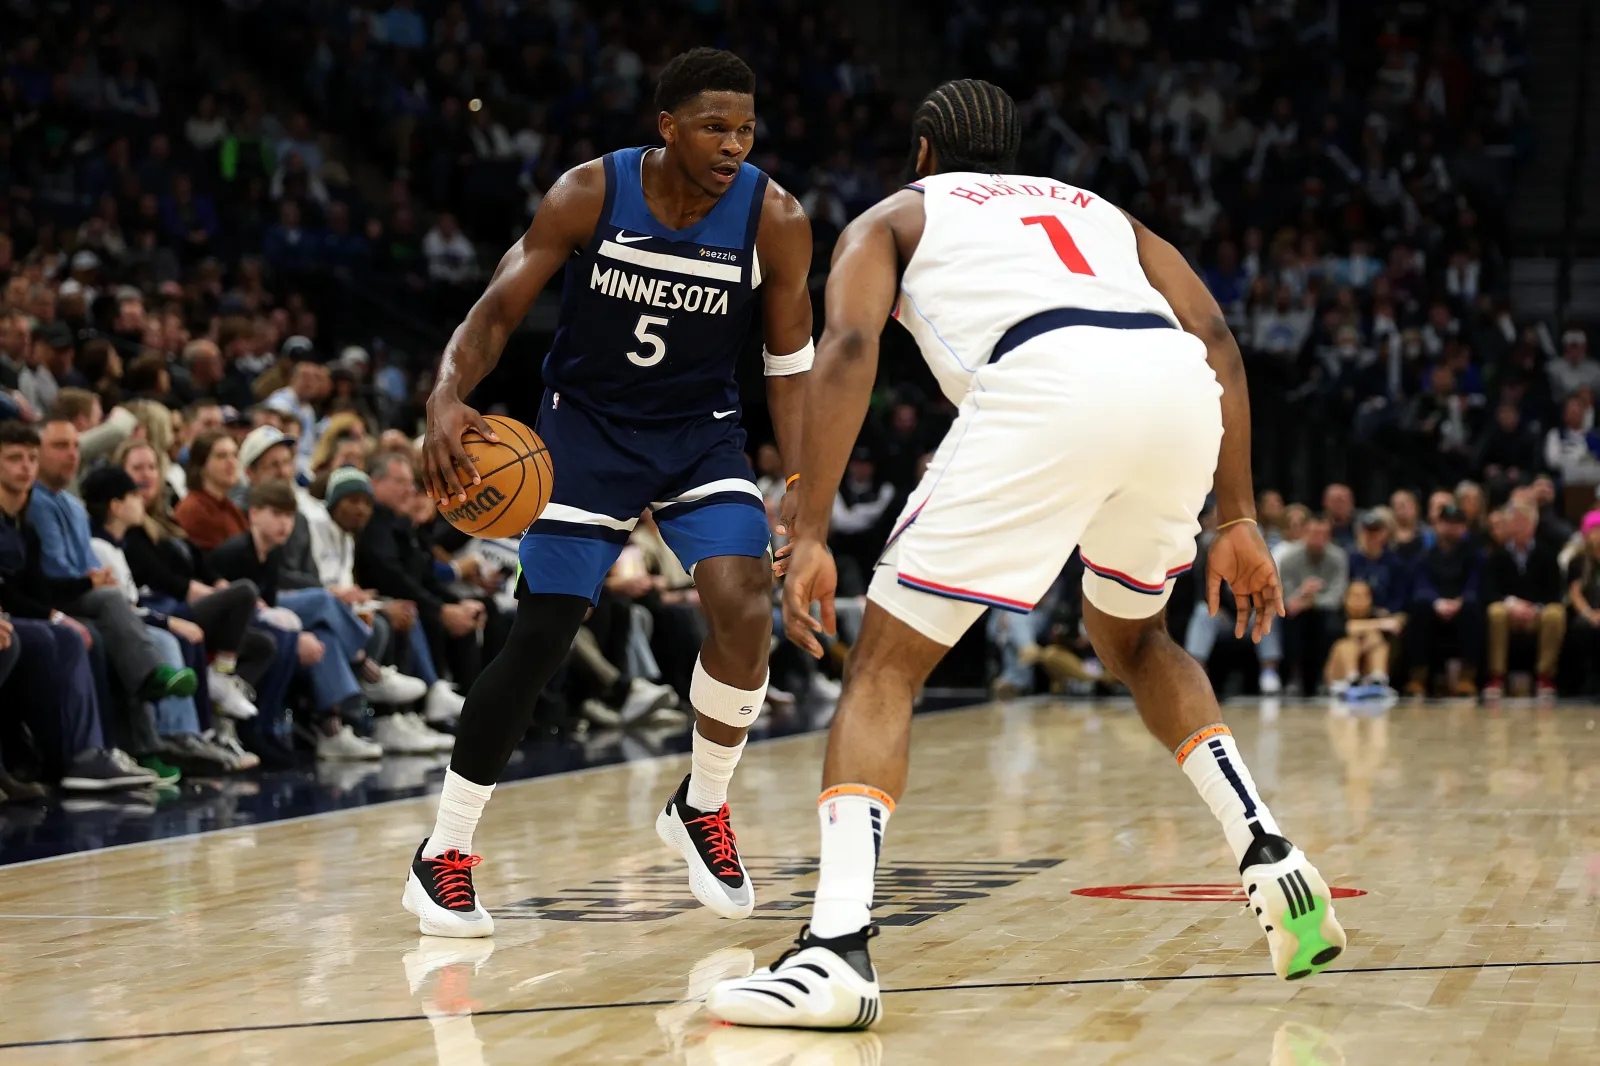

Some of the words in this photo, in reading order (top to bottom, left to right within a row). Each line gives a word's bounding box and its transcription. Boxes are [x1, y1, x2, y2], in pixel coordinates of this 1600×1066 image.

[949, 182, 1095, 208] HARDEN
[705, 249, 737, 262] sezzle
[1020, 215, 1097, 277] 1
[590, 263, 729, 315] MINNESOTA
[626, 314, 667, 367] 5
[738, 705, 754, 716] 5
